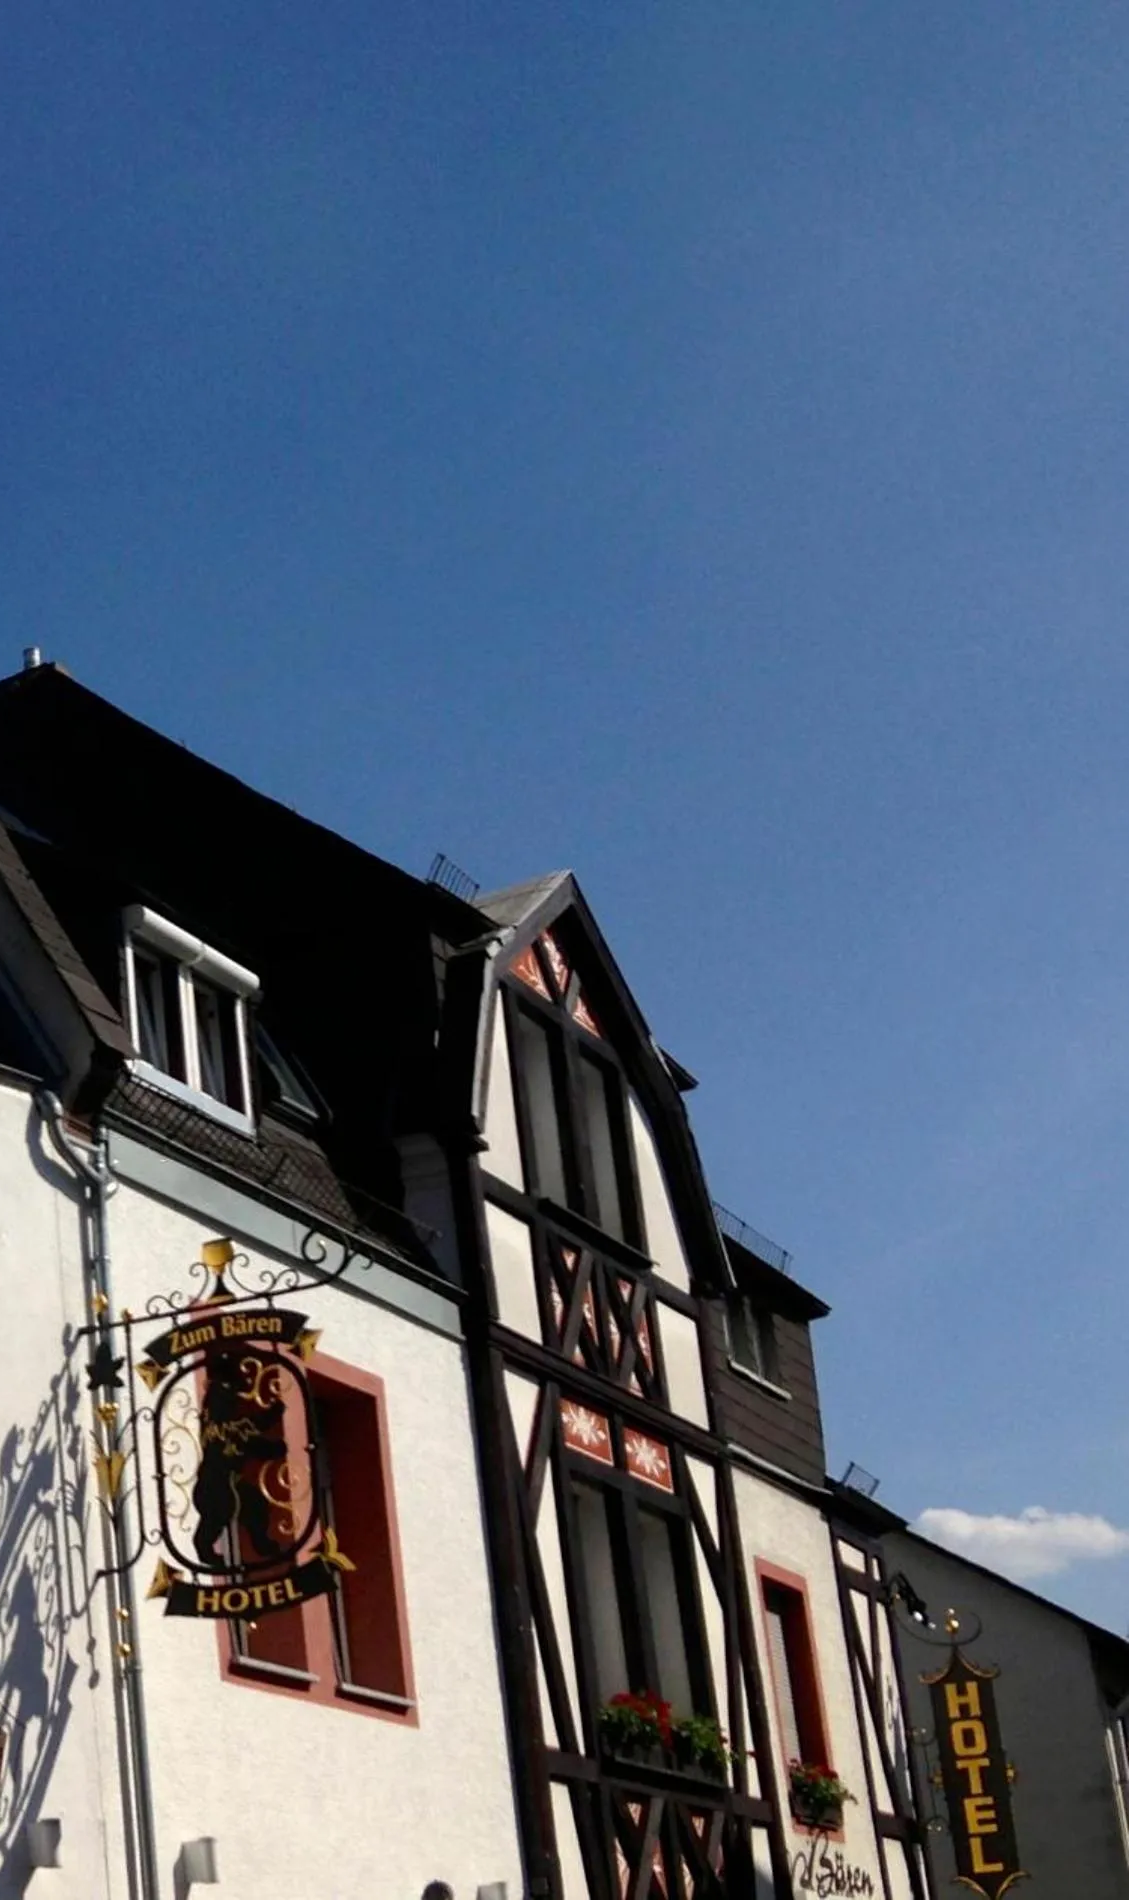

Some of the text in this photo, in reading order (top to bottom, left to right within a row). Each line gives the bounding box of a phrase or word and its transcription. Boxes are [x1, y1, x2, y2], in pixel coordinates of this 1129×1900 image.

[169, 1314, 282, 1354] Zum Bären
[197, 1578, 303, 1612] HOTEL
[945, 1681, 1004, 1874] HOTEL
